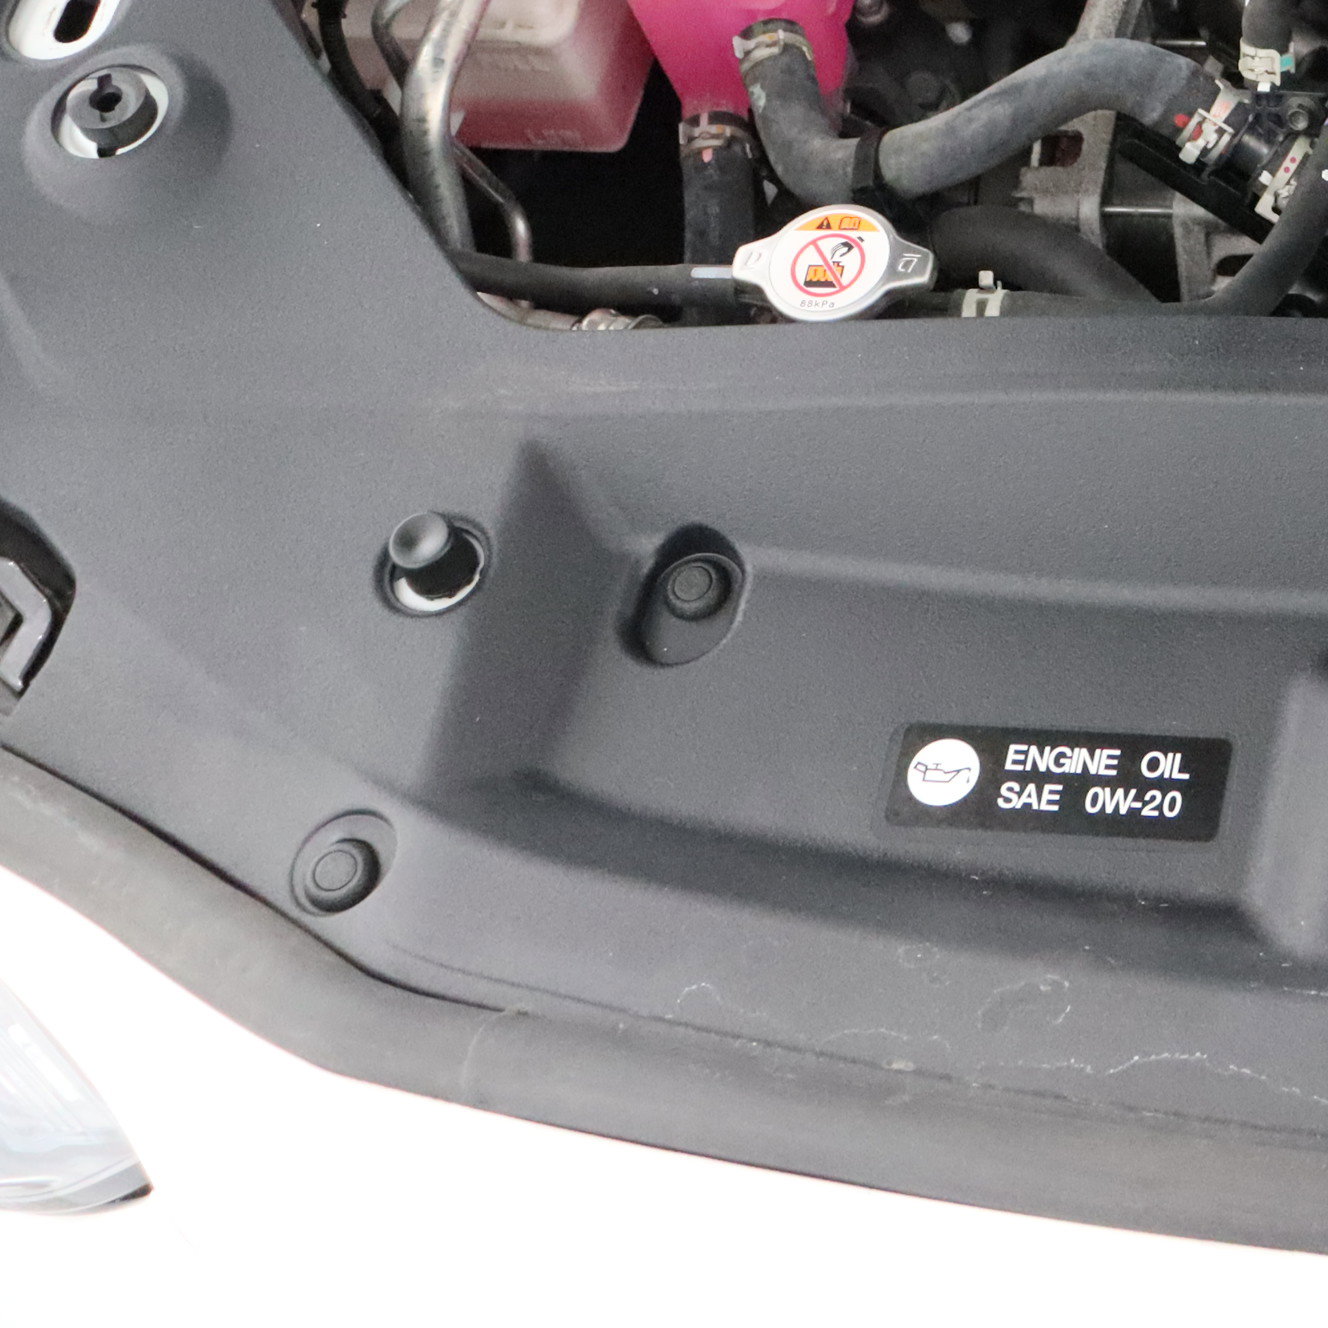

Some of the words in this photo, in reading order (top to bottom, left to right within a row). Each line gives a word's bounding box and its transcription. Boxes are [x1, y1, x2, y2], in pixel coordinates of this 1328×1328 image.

[1004, 744, 1121, 776] ENGINE
[1140, 750, 1191, 780] OIL
[996, 781, 1064, 811] SAE
[1084, 786, 1183, 818] 0W-20
